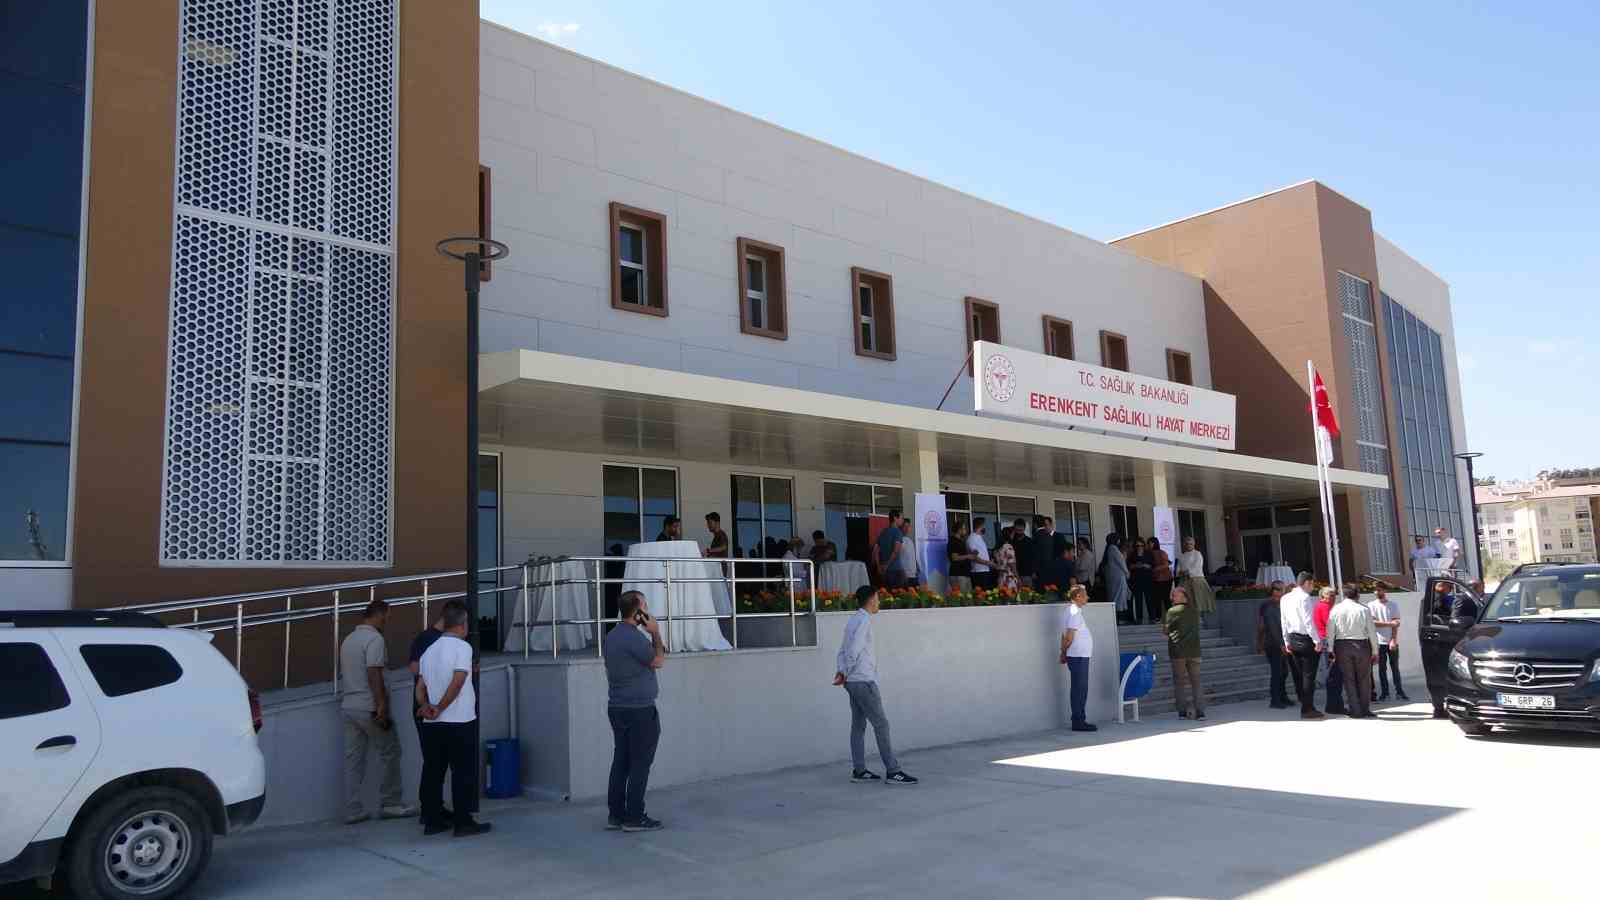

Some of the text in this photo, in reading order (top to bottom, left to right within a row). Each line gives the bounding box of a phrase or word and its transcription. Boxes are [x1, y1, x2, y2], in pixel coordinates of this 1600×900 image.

[1078, 371, 1190, 406] T.C. SAĞLIK BAKANLIĞI
[1030, 392, 1231, 441] ERENKENT SAĞLIKLI HAYAT MERKEZİ
[1503, 695, 1512, 704] 34
[1542, 696, 1553, 706] 26
